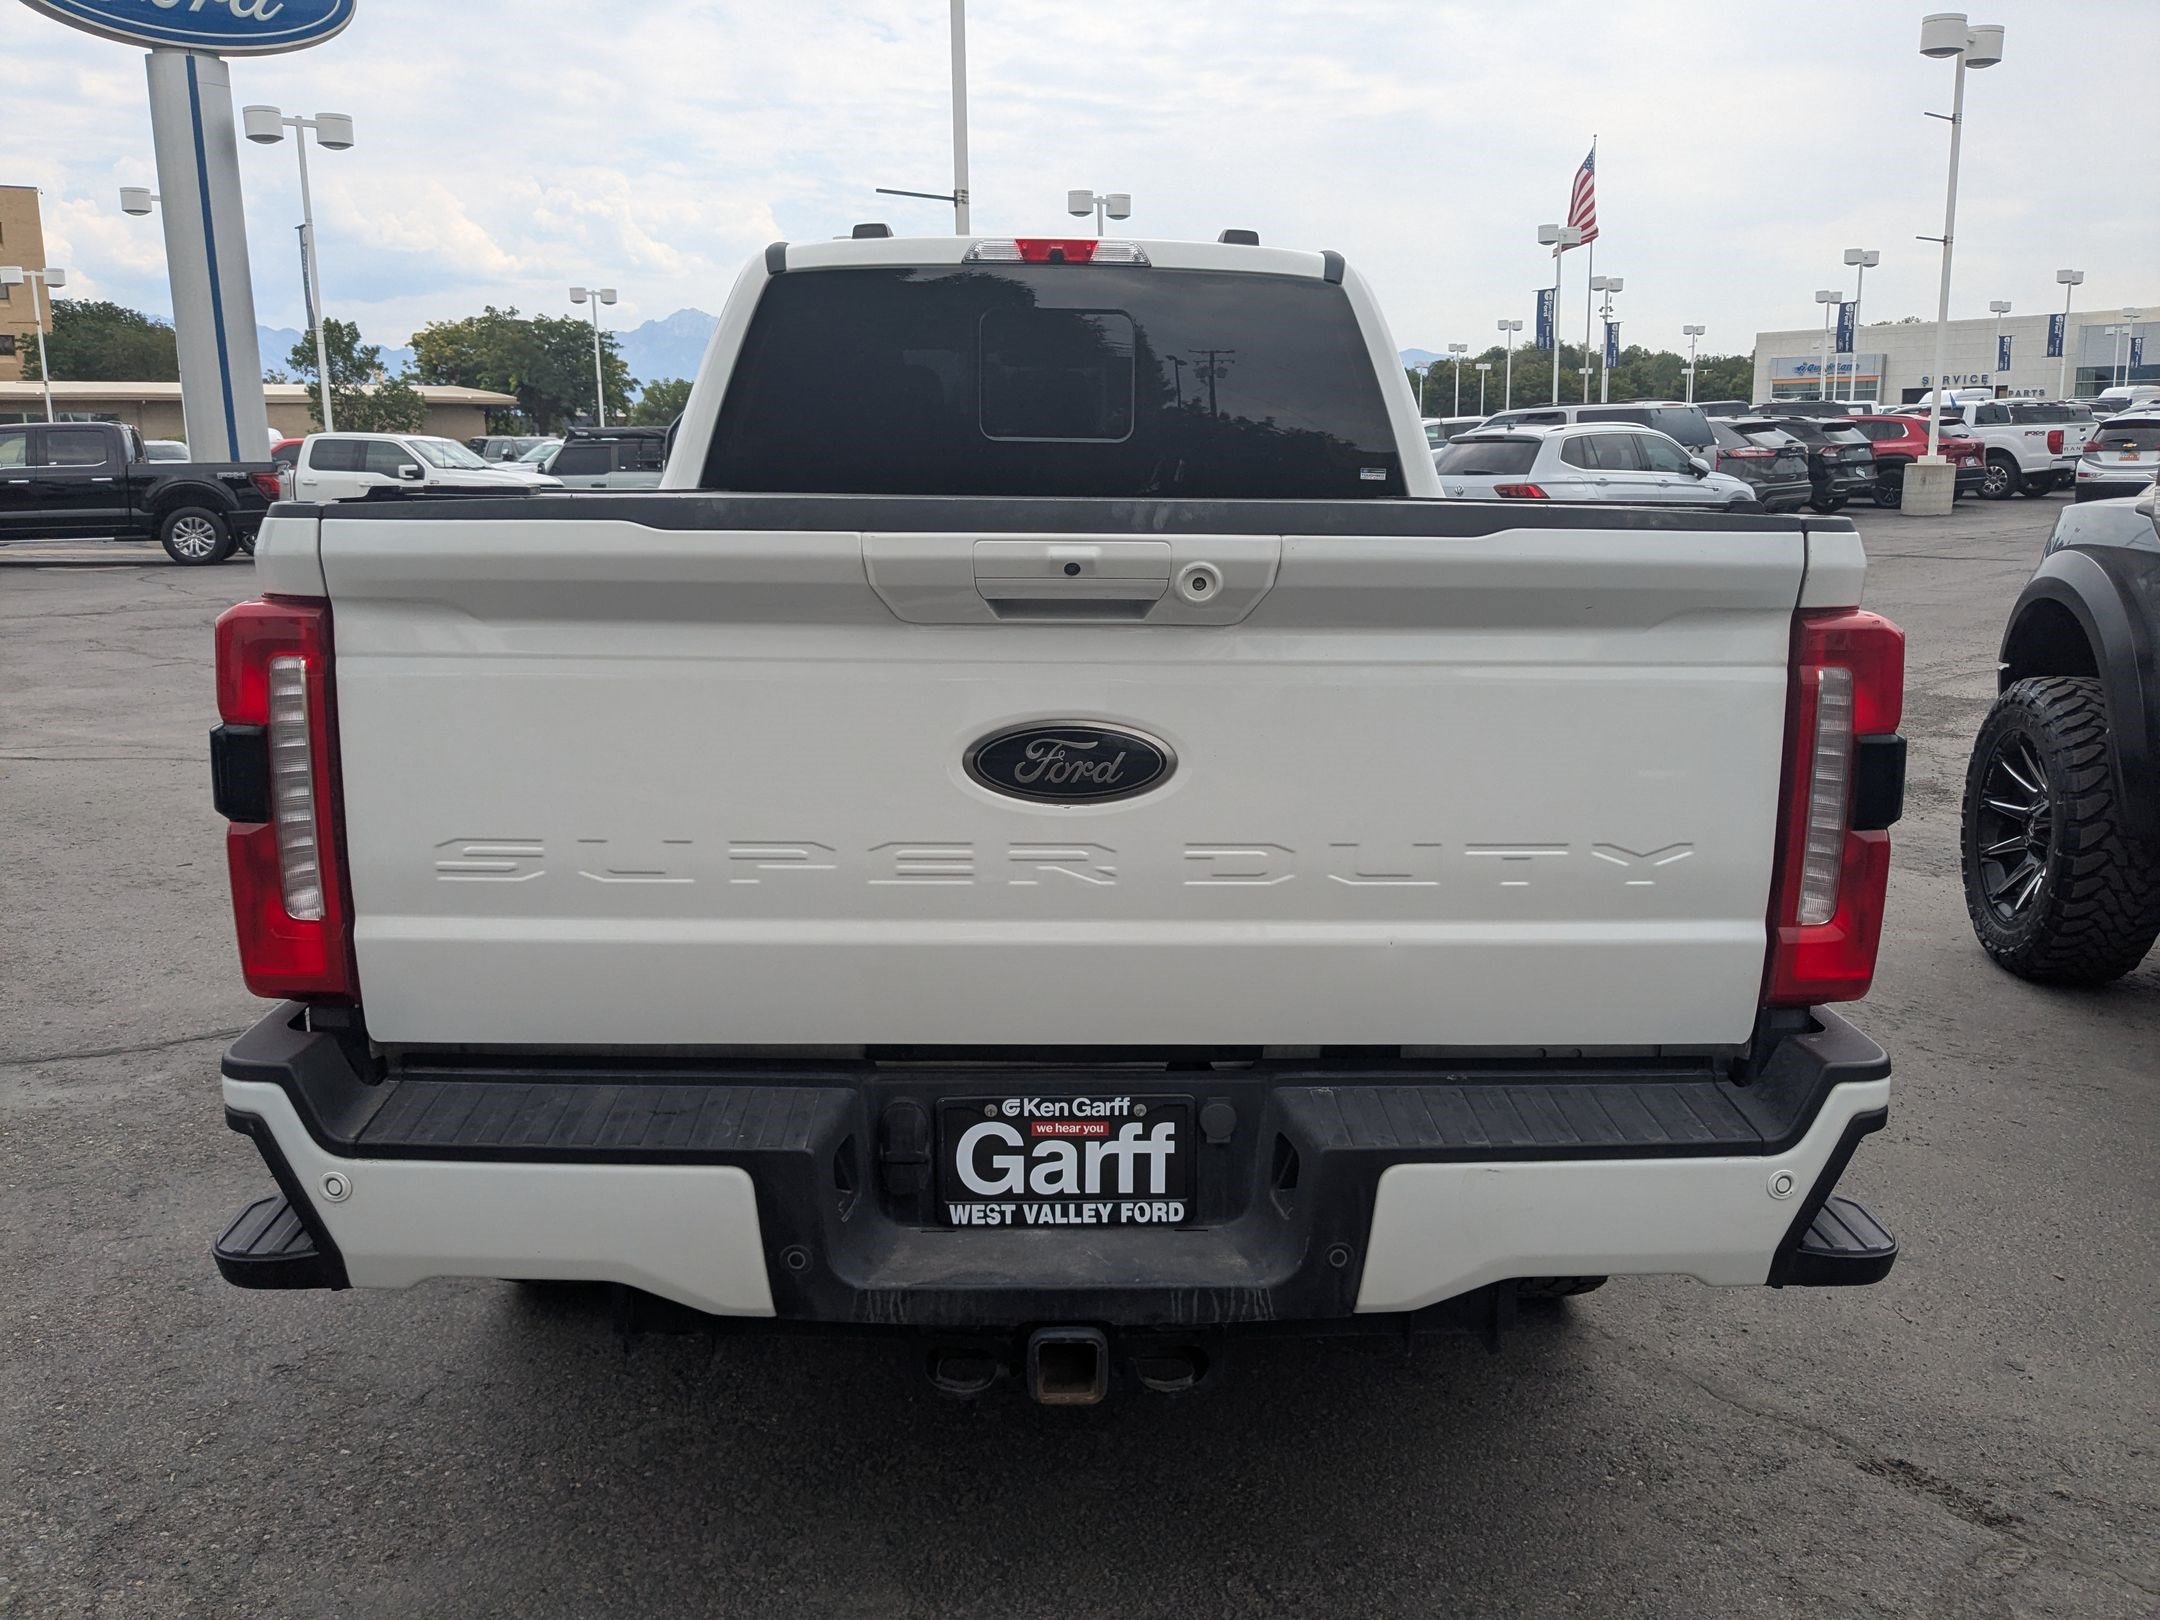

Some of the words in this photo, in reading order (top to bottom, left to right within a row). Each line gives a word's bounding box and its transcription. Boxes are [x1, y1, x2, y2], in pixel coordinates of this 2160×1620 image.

[1921, 375, 1989, 385] SRVICE
[2008, 389, 2045, 397] PARTS
[1014, 738, 1127, 784] Ford
[434, 838, 1116, 884] SUPER
[1184, 842, 1694, 885] DUTY
[1023, 1097, 1069, 1116] Ken
[1072, 1097, 1130, 1117] Garff
[1036, 1124, 1053, 1133] we
[1055, 1123, 1080, 1133] hear
[1082, 1124, 1104, 1135] you
[956, 1121, 1175, 1195] Garff
[949, 1204, 1014, 1225] WEST
[1025, 1203, 1113, 1224] VALLEY
[1120, 1202, 1185, 1223] FORD
